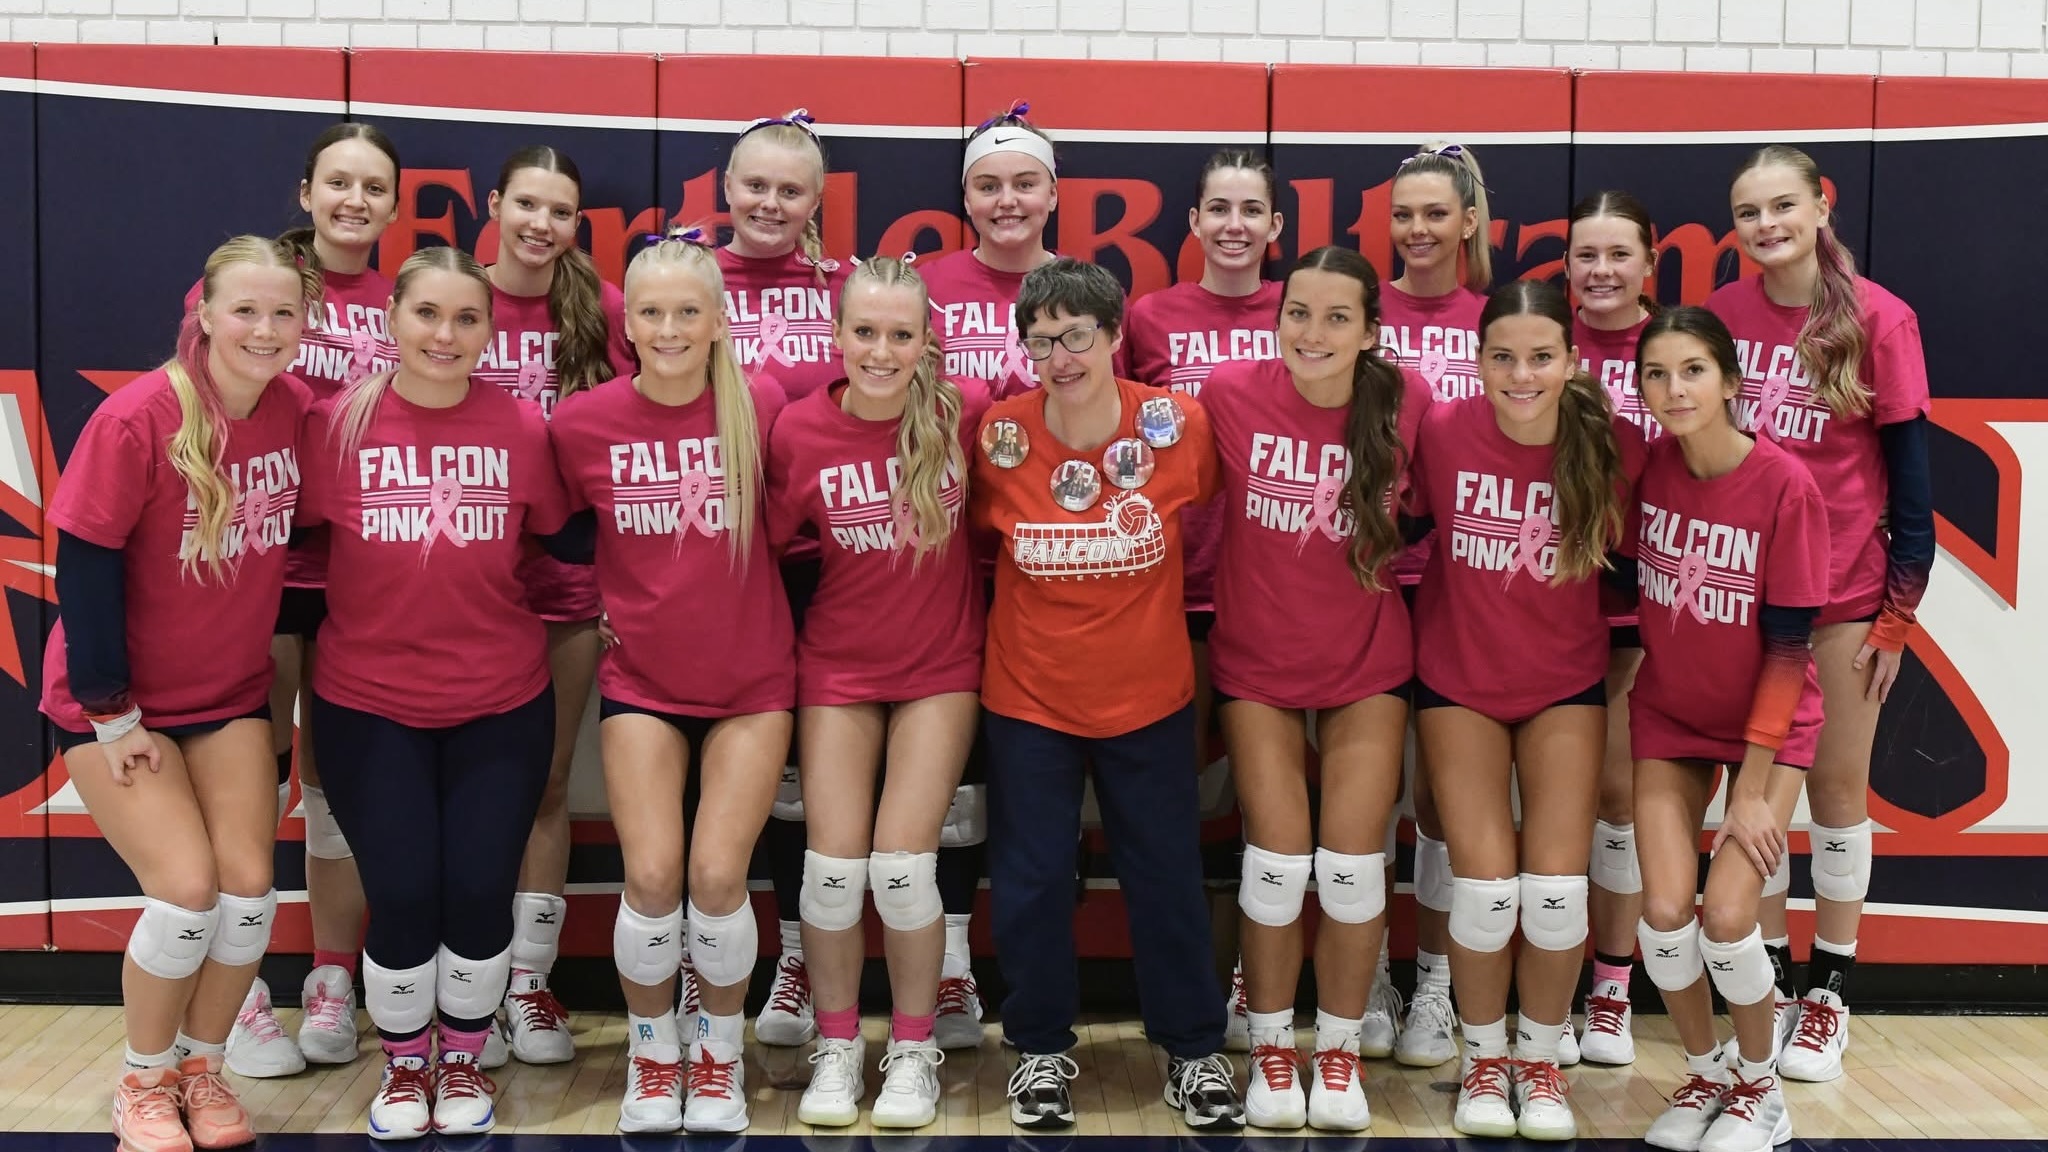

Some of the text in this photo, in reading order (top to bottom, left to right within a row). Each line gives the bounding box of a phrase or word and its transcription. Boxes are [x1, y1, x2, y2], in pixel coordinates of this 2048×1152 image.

[723, 287, 832, 322] ALCON
[945, 302, 1019, 336] FAL
[782, 335, 833, 363] OUT
[1168, 329, 1283, 366] FALCO
[1378, 326, 1481, 361] ALCON
[1775, 405, 1831, 443] OUT
[359, 446, 509, 490] FALCON
[610, 437, 724, 484] FALCO
[1250, 432, 1354, 484] FALC
[1246, 491, 1312, 533] PINK
[1456, 470, 1560, 525] FALC
[361, 506, 508, 541] PINK OUT
[615, 502, 681, 535] PINK
[831, 521, 896, 554] PINK
[1016, 538, 1132, 564] FALCON
[1452, 531, 1519, 571] PINK
[1640, 501, 1760, 574] FALCON
[1637, 558, 1755, 626] PINK OUT
